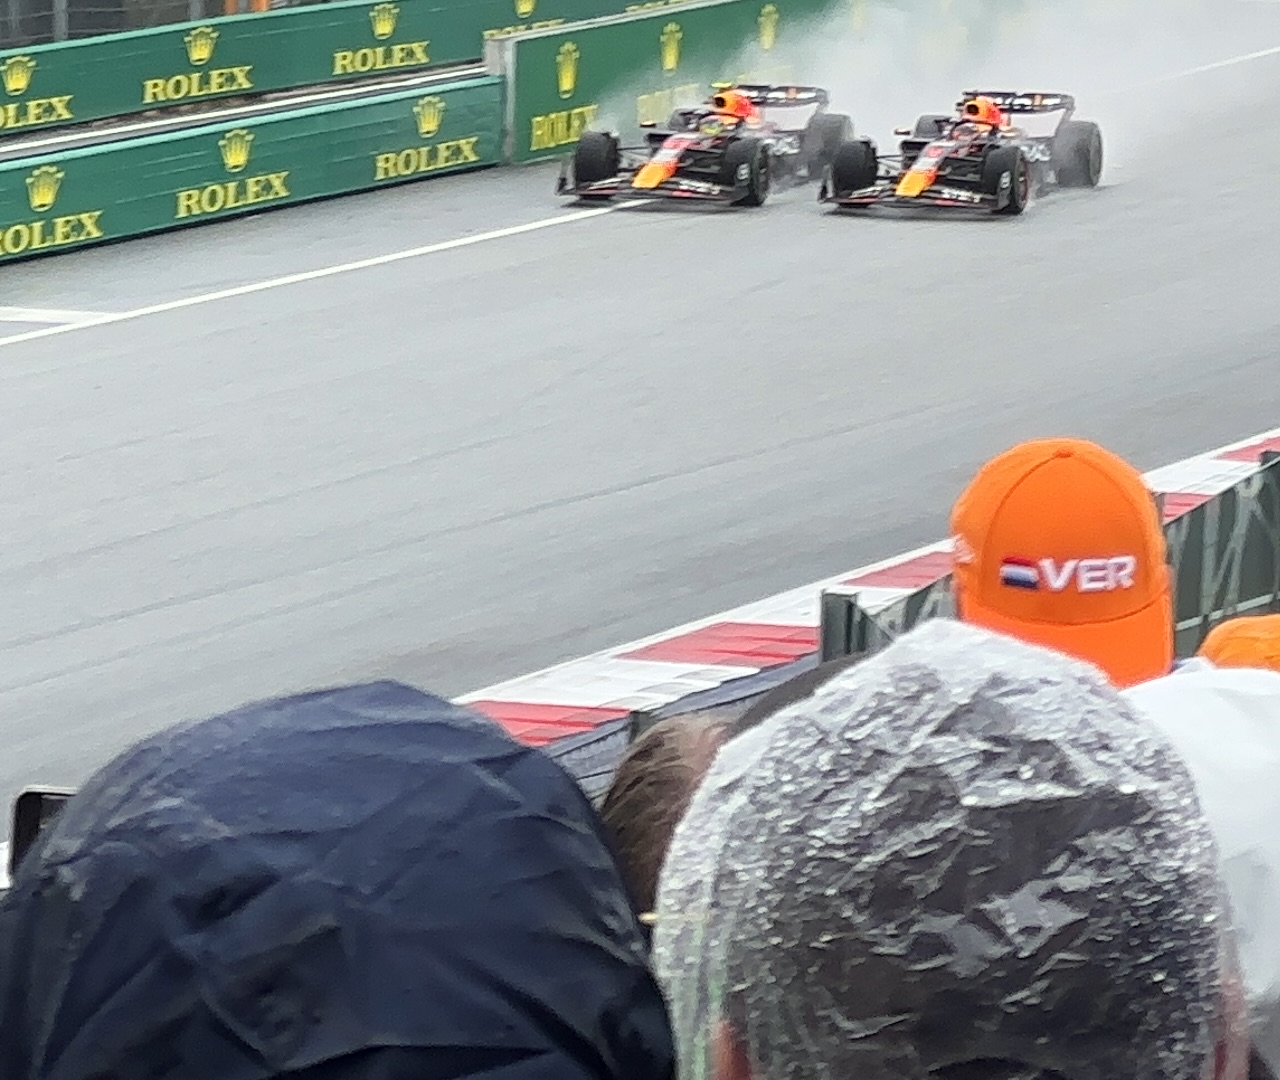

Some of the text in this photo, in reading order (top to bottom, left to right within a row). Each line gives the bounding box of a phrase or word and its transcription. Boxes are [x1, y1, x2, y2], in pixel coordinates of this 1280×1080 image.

[333, 41, 430, 76] ROLEX
[143, 66, 254, 104] ROLEX
[0, 95, 74, 129] LEX
[374, 137, 480, 181] ROLEX
[175, 171, 291, 218] ROLEX
[0, 210, 104, 256] OLEX
[1039, 554, 1138, 594] VER
